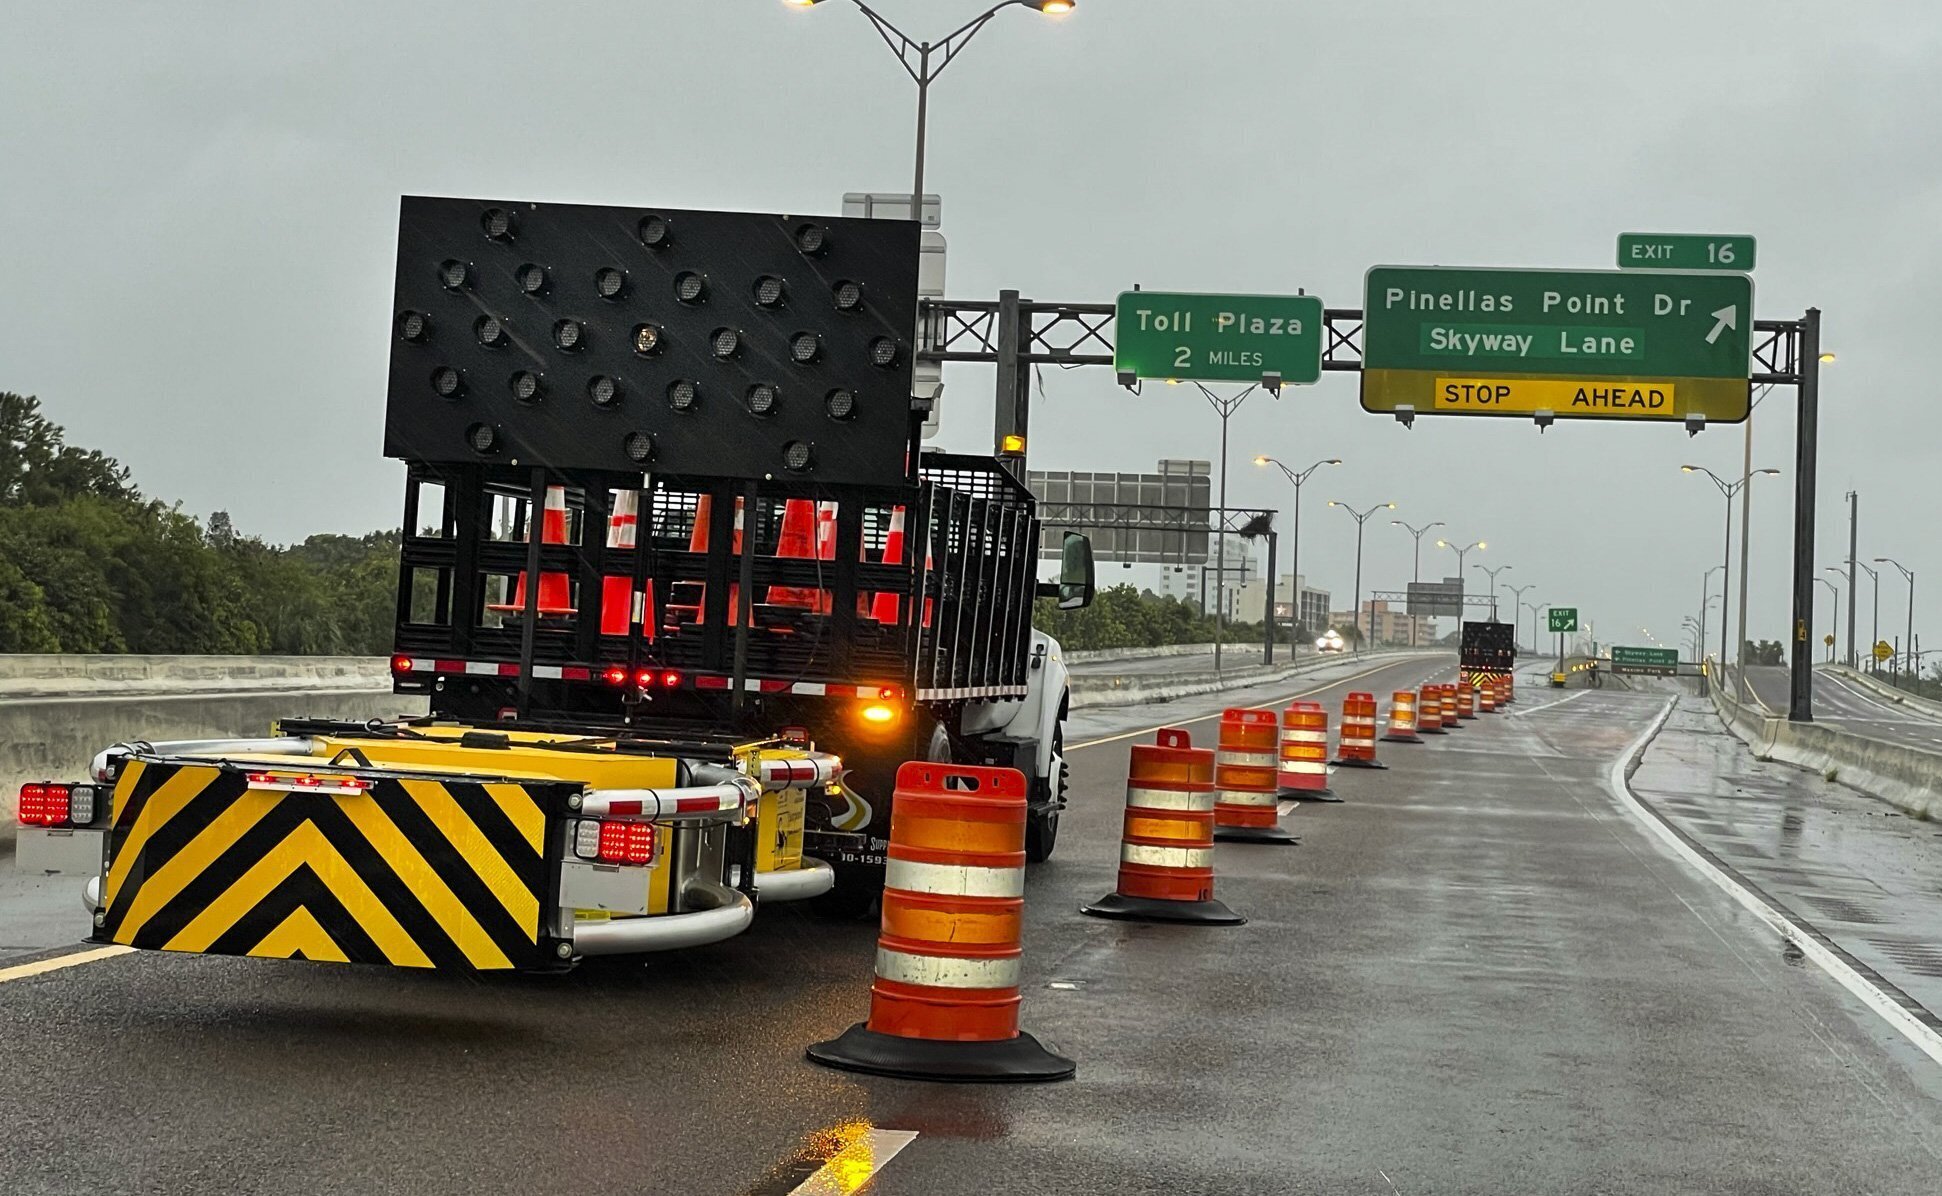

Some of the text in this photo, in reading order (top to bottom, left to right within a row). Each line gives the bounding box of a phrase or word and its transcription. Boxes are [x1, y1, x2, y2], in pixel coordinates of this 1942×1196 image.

[1632, 243, 1735, 264] EXIT 16
[1386, 288, 1692, 316] Pinellas Point Dr
[1136, 309, 1302, 335] Toll Plaza
[1430, 327, 1635, 357] Skyway Lane
[1173, 346, 1263, 368] 2 MILES
[1444, 384, 1665, 409] STOP AHEAD
[1551, 618, 1561, 628] 16
